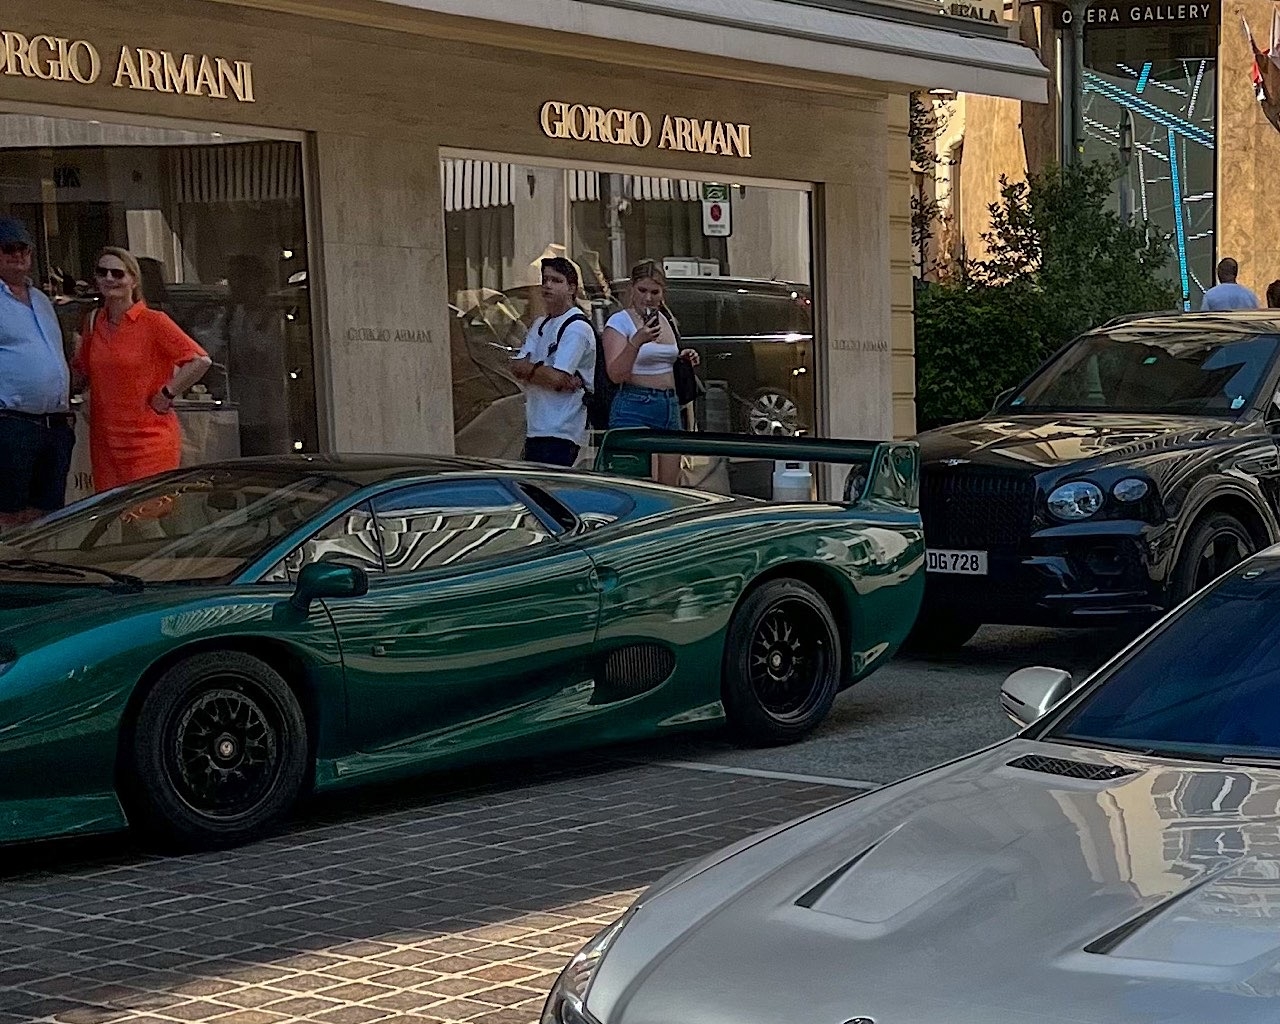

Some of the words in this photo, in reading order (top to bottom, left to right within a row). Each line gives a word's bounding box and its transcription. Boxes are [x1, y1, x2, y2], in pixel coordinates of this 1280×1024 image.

[1062, 8, 1120, 24] OERA
[1130, 4, 1210, 21] GALLERY
[0, 31, 100, 84] RGIO
[112, 45, 256, 103] ARMANI
[540, 101, 651, 148] GIORGIO
[657, 114, 752, 158] ARMANI
